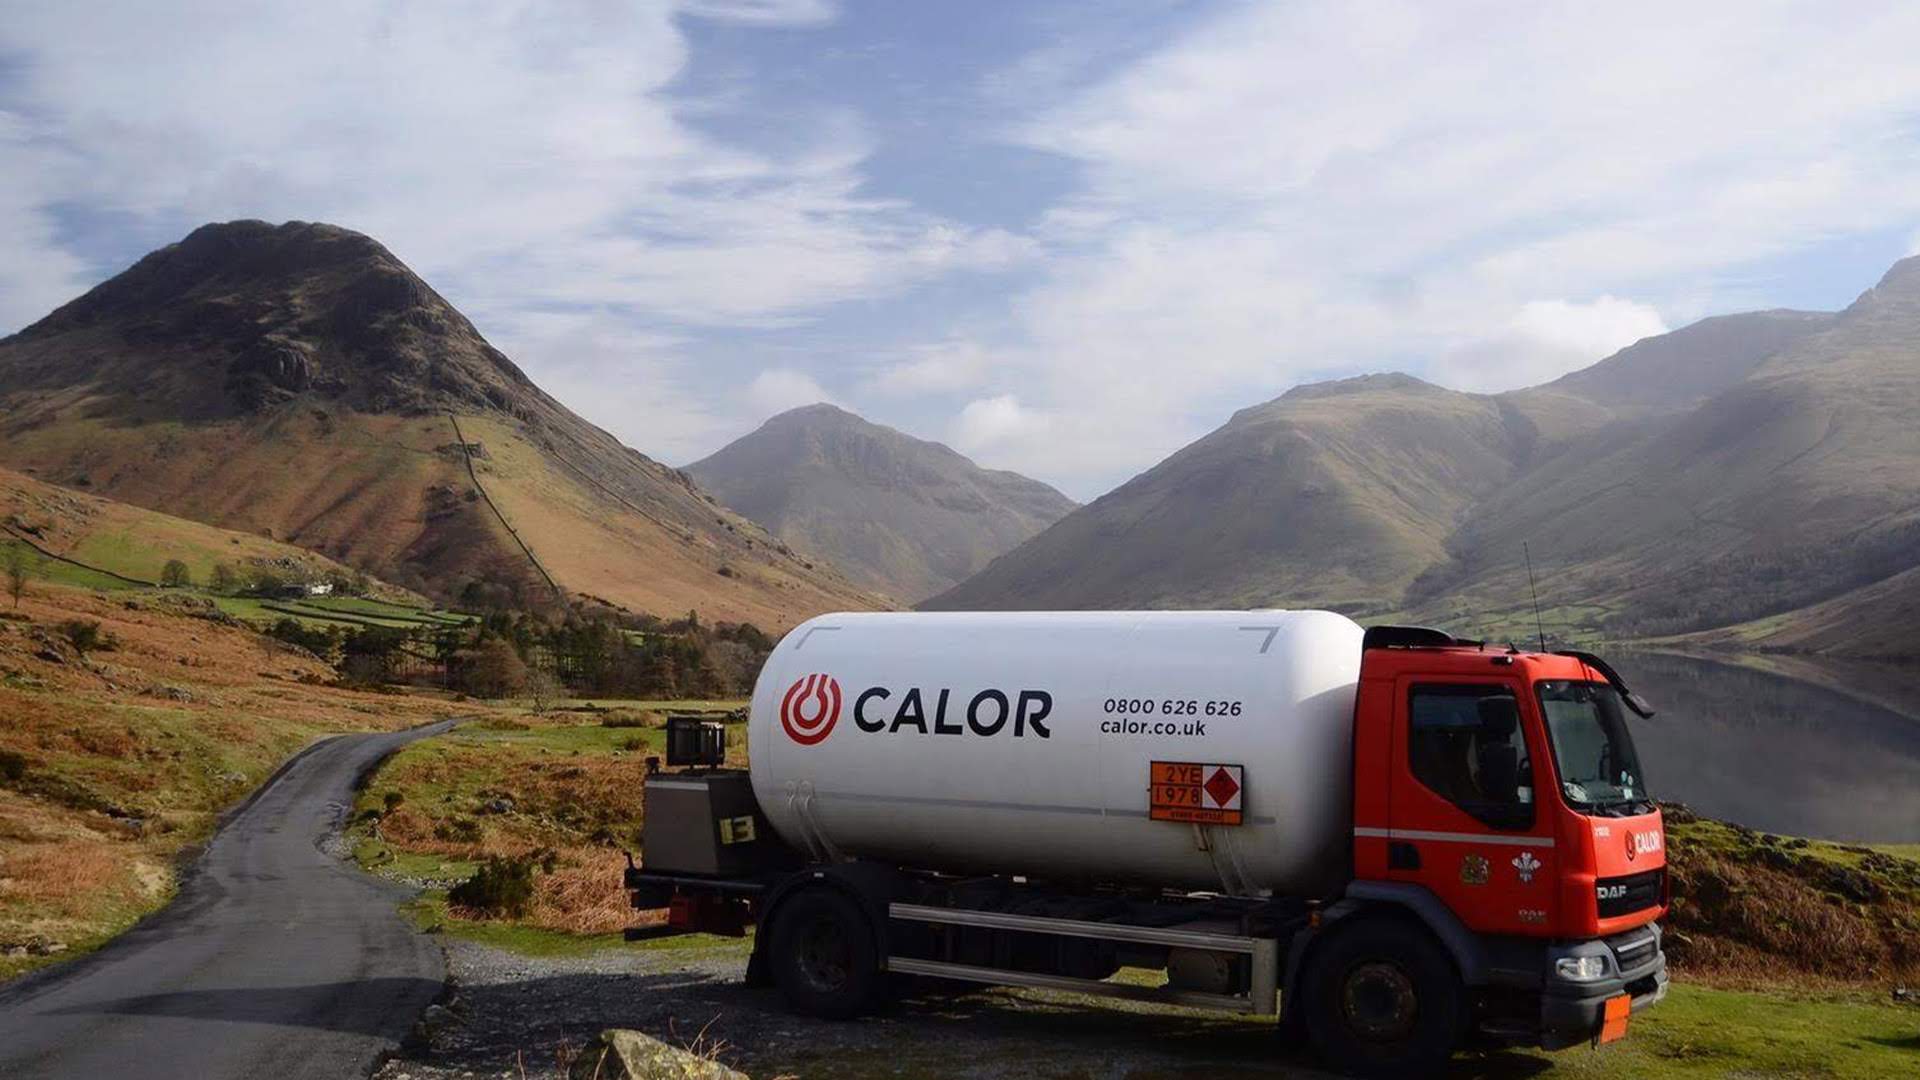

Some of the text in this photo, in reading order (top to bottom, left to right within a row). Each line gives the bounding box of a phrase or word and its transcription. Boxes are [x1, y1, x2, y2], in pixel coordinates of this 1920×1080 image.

[853, 686, 1053, 739] CALOR
[1103, 699, 1242, 716] 0800 626 626
[1100, 718, 1206, 736] calor.co.uk
[1166, 766, 1201, 783] 2YE
[1155, 786, 1201, 804] 1978
[1596, 885, 1627, 899] DAF
